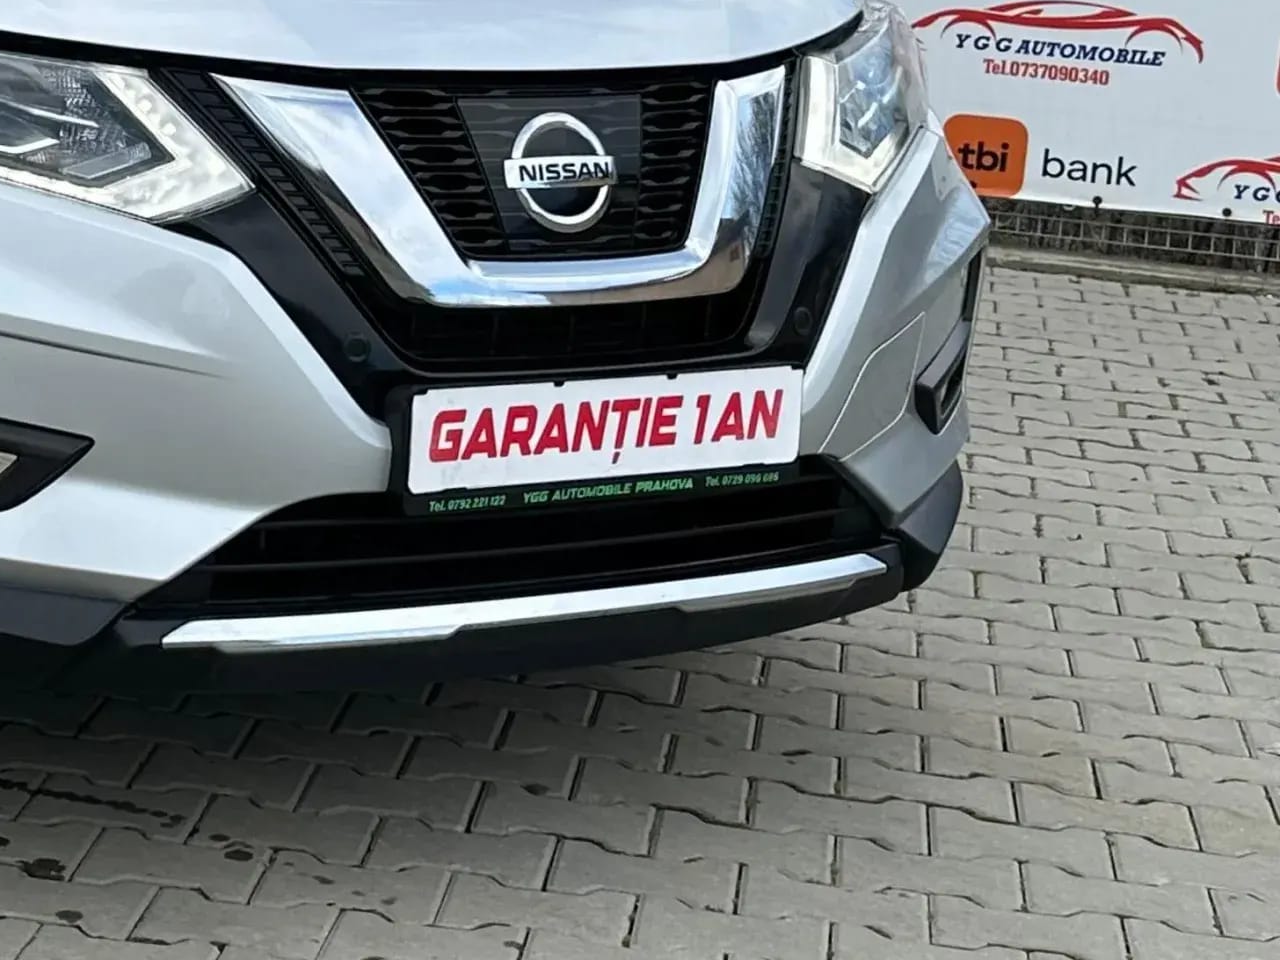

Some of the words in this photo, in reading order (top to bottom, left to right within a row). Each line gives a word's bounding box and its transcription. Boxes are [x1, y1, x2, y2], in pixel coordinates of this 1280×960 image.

[1014, 40, 1165, 67] AUTOMOBILE
[519, 161, 610, 182] NISSAN
[957, 141, 1010, 173] tbi
[1041, 147, 1137, 187] bank
[428, 394, 684, 465] GARANȚIE
[523, 490, 550, 504] YGG
[551, 483, 631, 501] AUTOMOBILE
[635, 477, 694, 493] PRAHOVA
